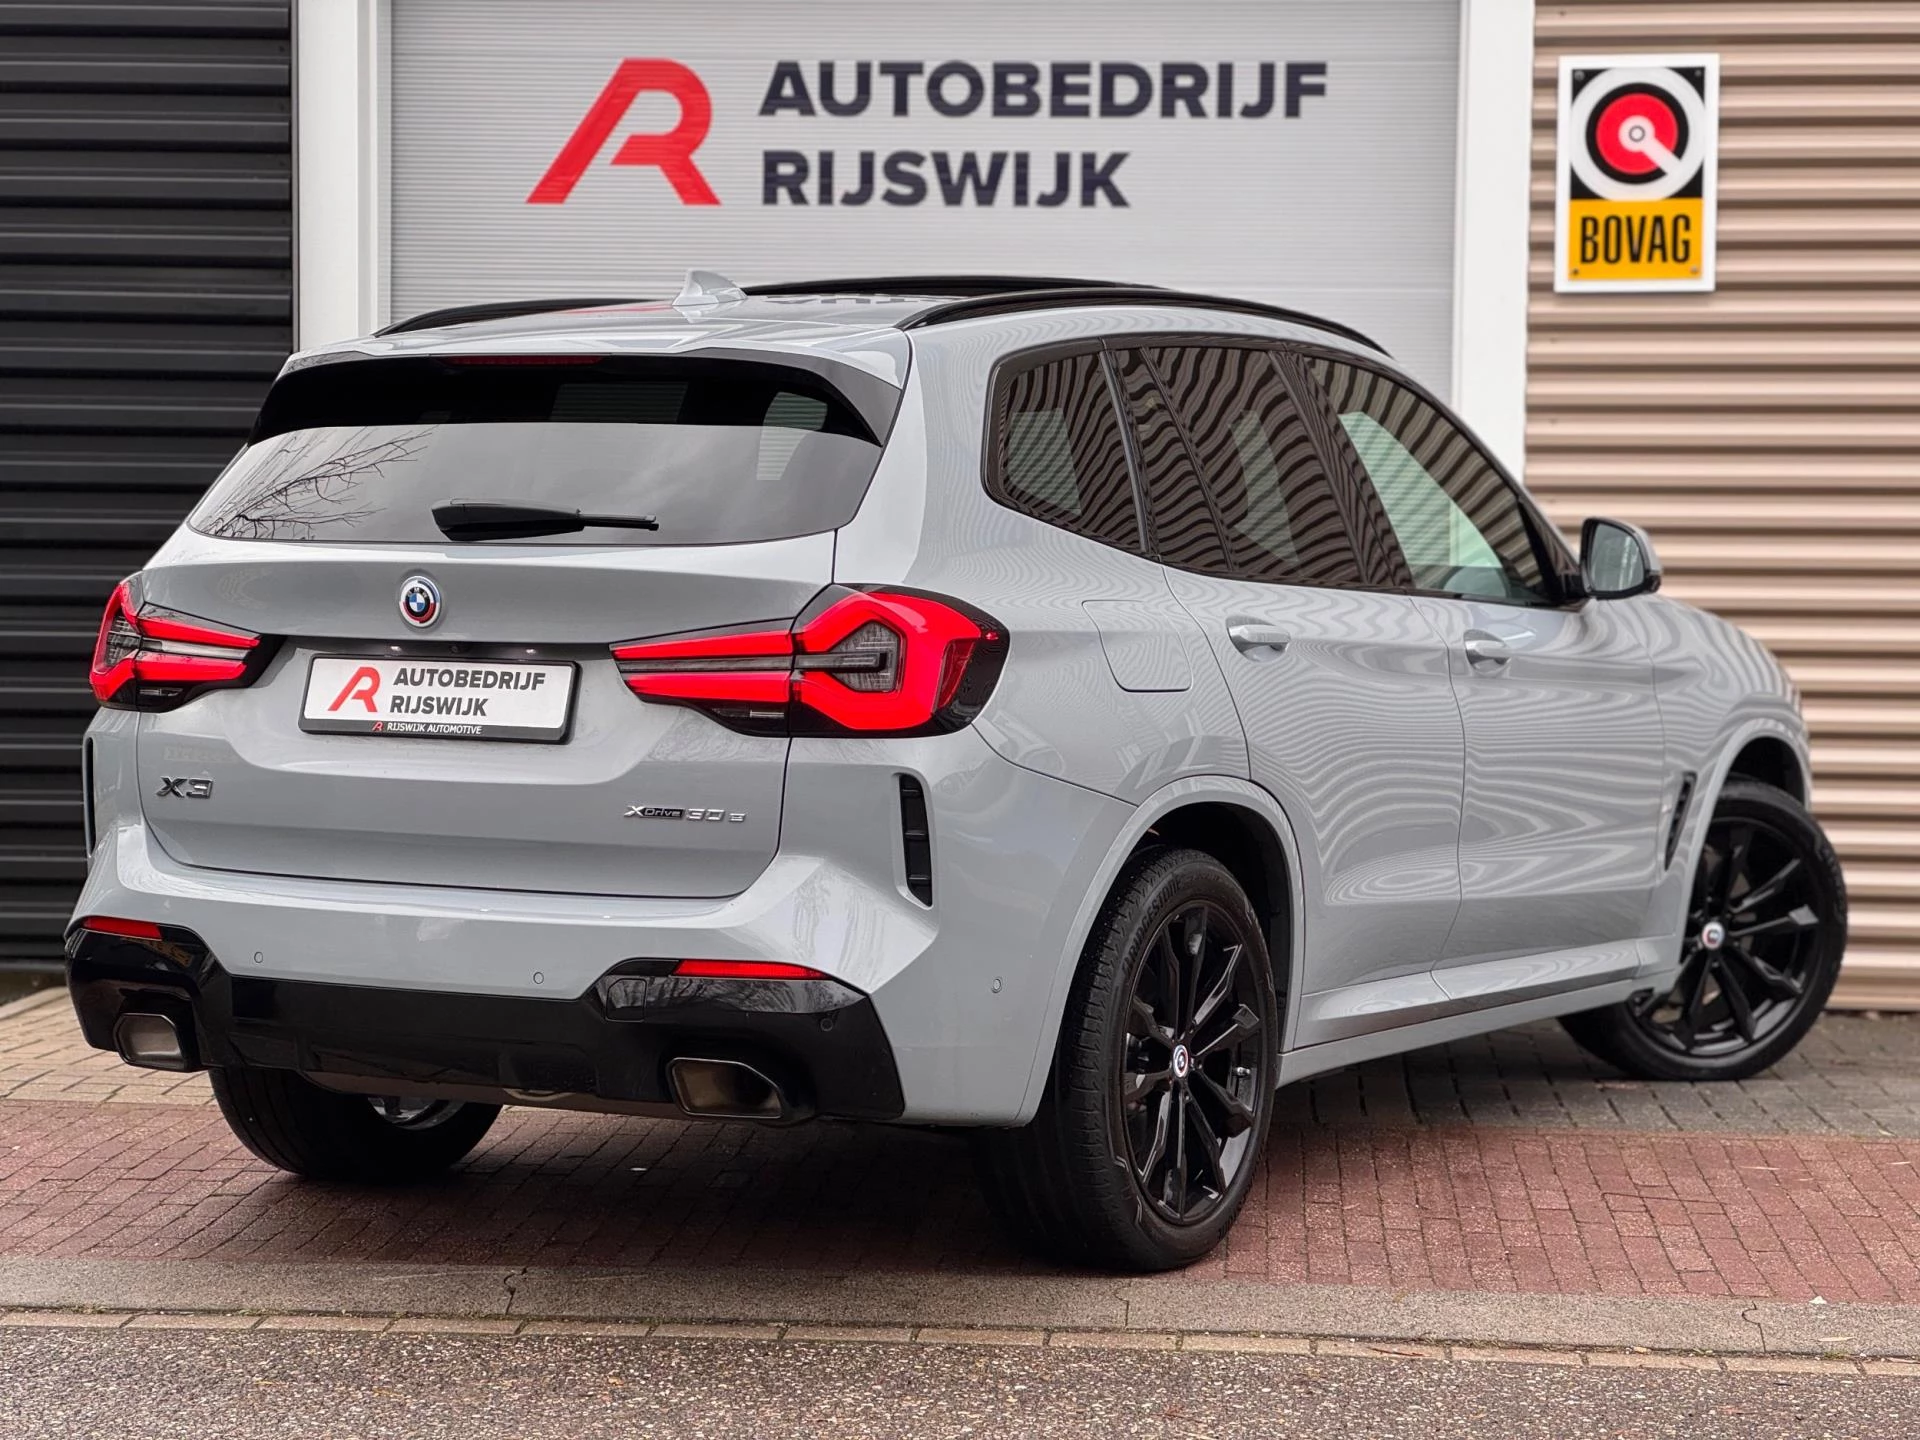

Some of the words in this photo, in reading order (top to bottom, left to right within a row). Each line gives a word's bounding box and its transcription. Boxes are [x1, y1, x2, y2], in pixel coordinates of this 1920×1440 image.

[759, 60, 1328, 119] AUTOBEDRIJF
[762, 150, 1131, 208] RIJSWIJK
[1580, 214, 1691, 265] BOVAG
[393, 667, 546, 691] AUTOBEDRIJF
[389, 695, 487, 717] RIJSWIJK
[386, 722, 426, 733] RIJSWIJK
[427, 724, 482, 735] AUTOMOTIVE
[156, 776, 214, 799] X3
[686, 808, 725, 821] 30
